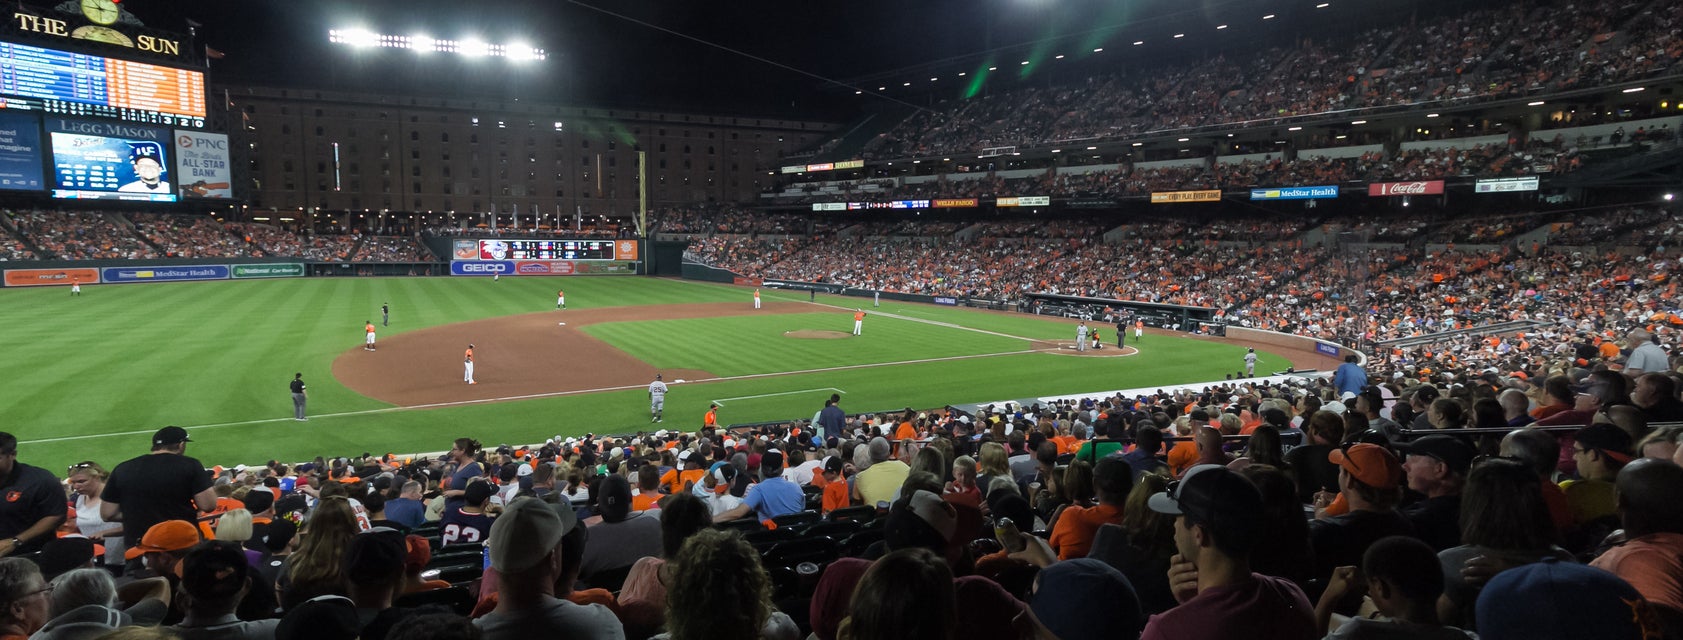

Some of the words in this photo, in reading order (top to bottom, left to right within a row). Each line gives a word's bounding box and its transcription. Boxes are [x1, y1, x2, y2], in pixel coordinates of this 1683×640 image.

[14, 12, 68, 37] THE
[137, 35, 179, 56] SUN
[163, 117, 172, 125] 3
[180, 119, 189, 127] 2
[194, 120, 204, 128] 0
[61, 120, 102, 134] LEGG
[106, 124, 157, 139] MASON
[195, 138, 226, 150] PNC
[182, 159, 225, 169] ALL-STAR
[192, 168, 216, 178] BANK
[1280, 188, 1310, 199] MedStar
[1311, 186, 1337, 198] Health
[1390, 181, 1427, 195] Coca-Cola
[462, 263, 506, 272] GEICO
[442, 524, 481, 548] 23
